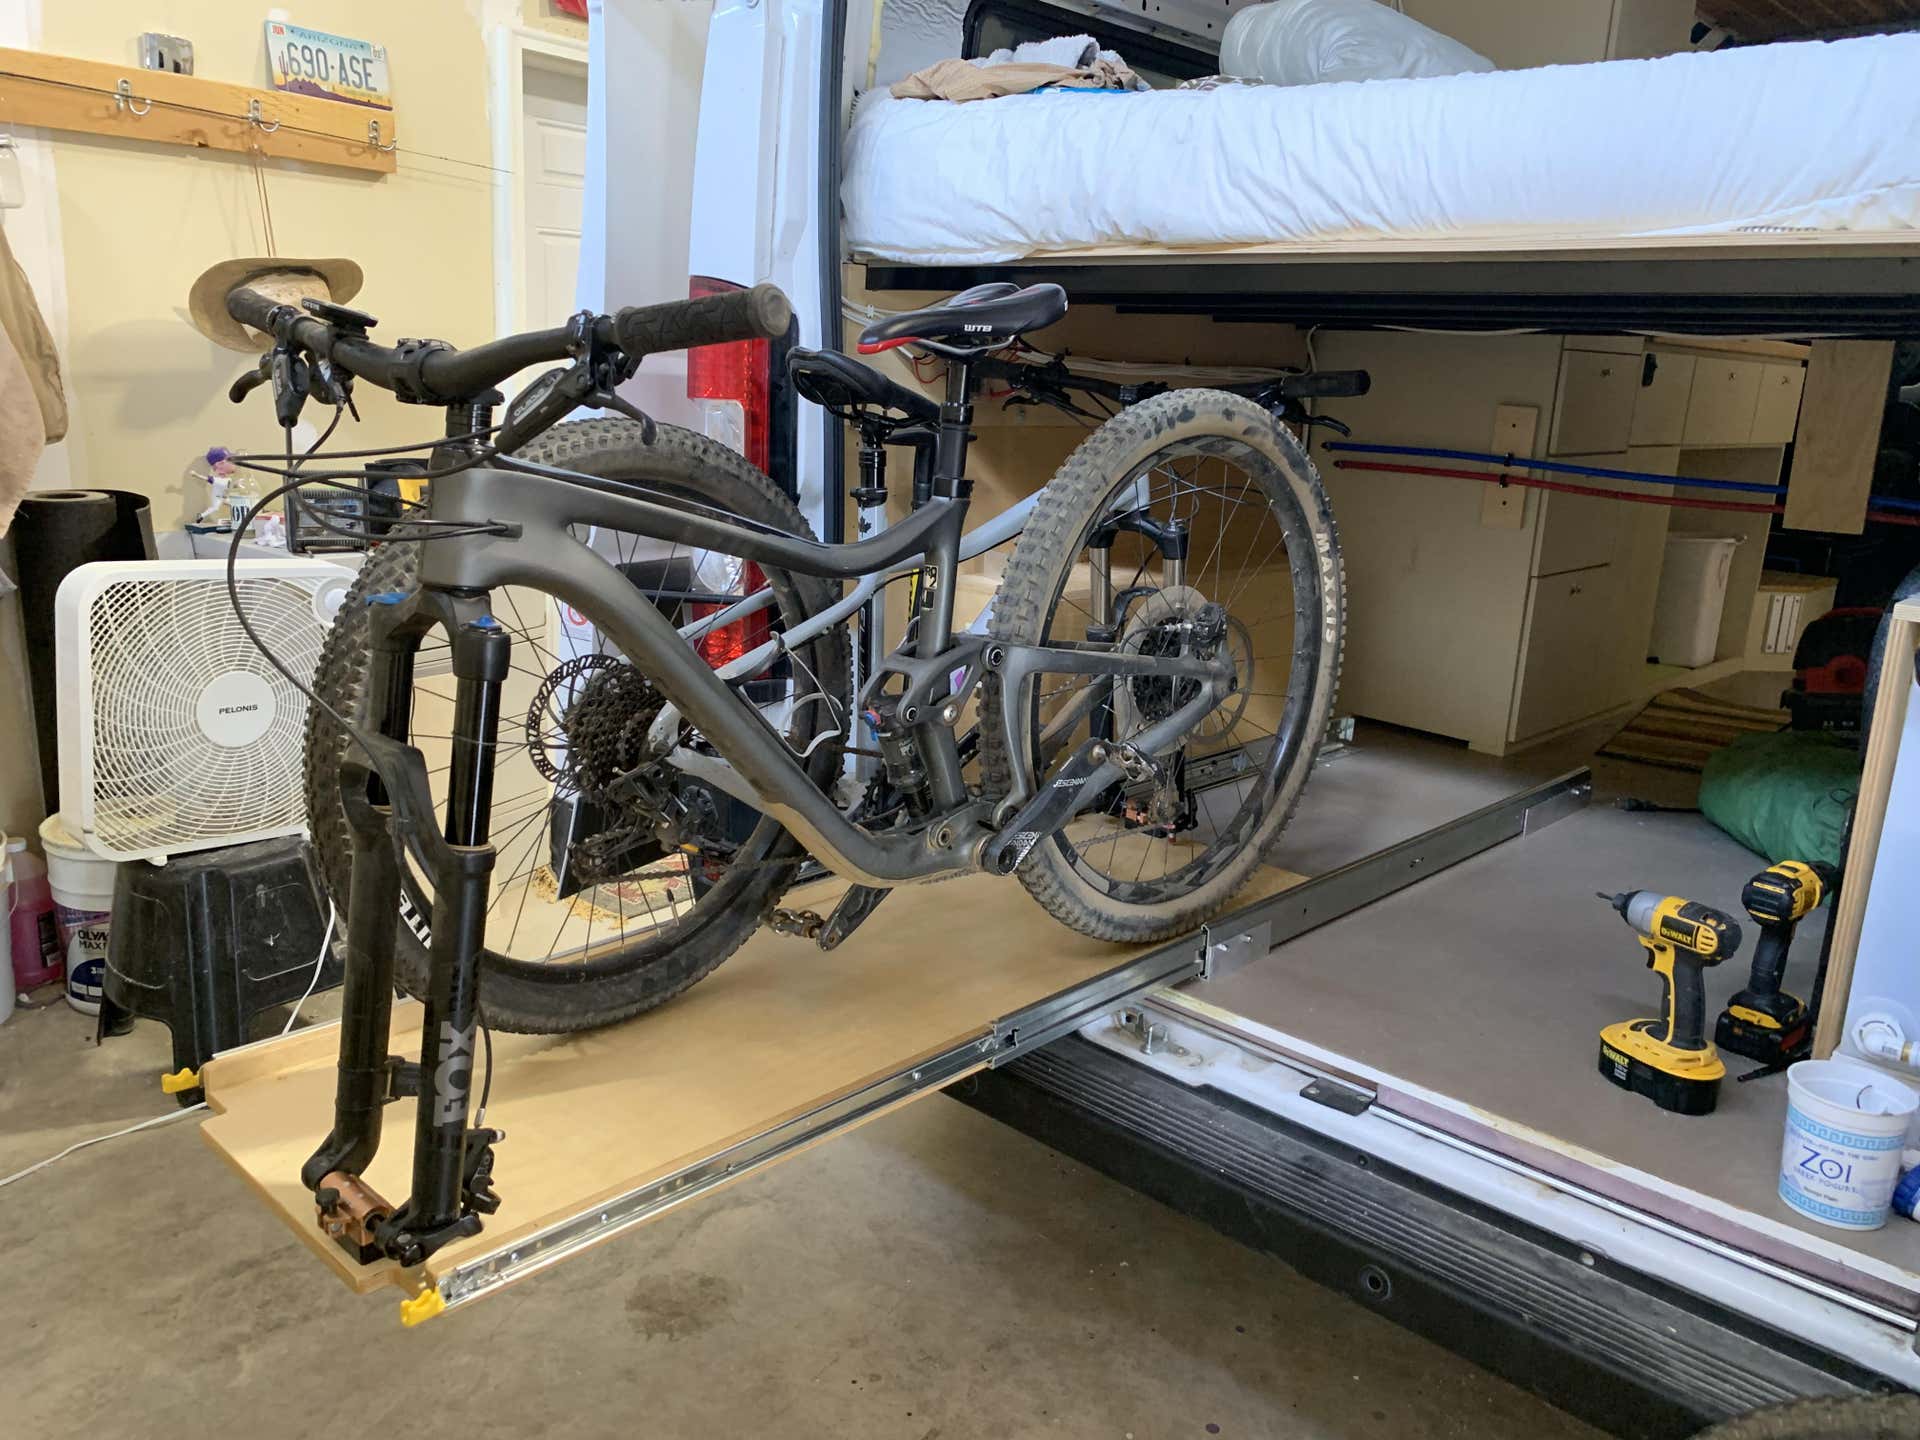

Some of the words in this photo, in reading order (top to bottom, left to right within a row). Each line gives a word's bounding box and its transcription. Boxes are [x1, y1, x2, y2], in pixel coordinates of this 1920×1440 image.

[964, 324, 992, 333] WTB
[1315, 533, 1337, 643] MAXXIS
[219, 704, 258, 715] PELONIS
[78, 929, 108, 941] OLYM
[433, 1015, 478, 1127] FOX
[1800, 1145, 1852, 1184] ZOI
